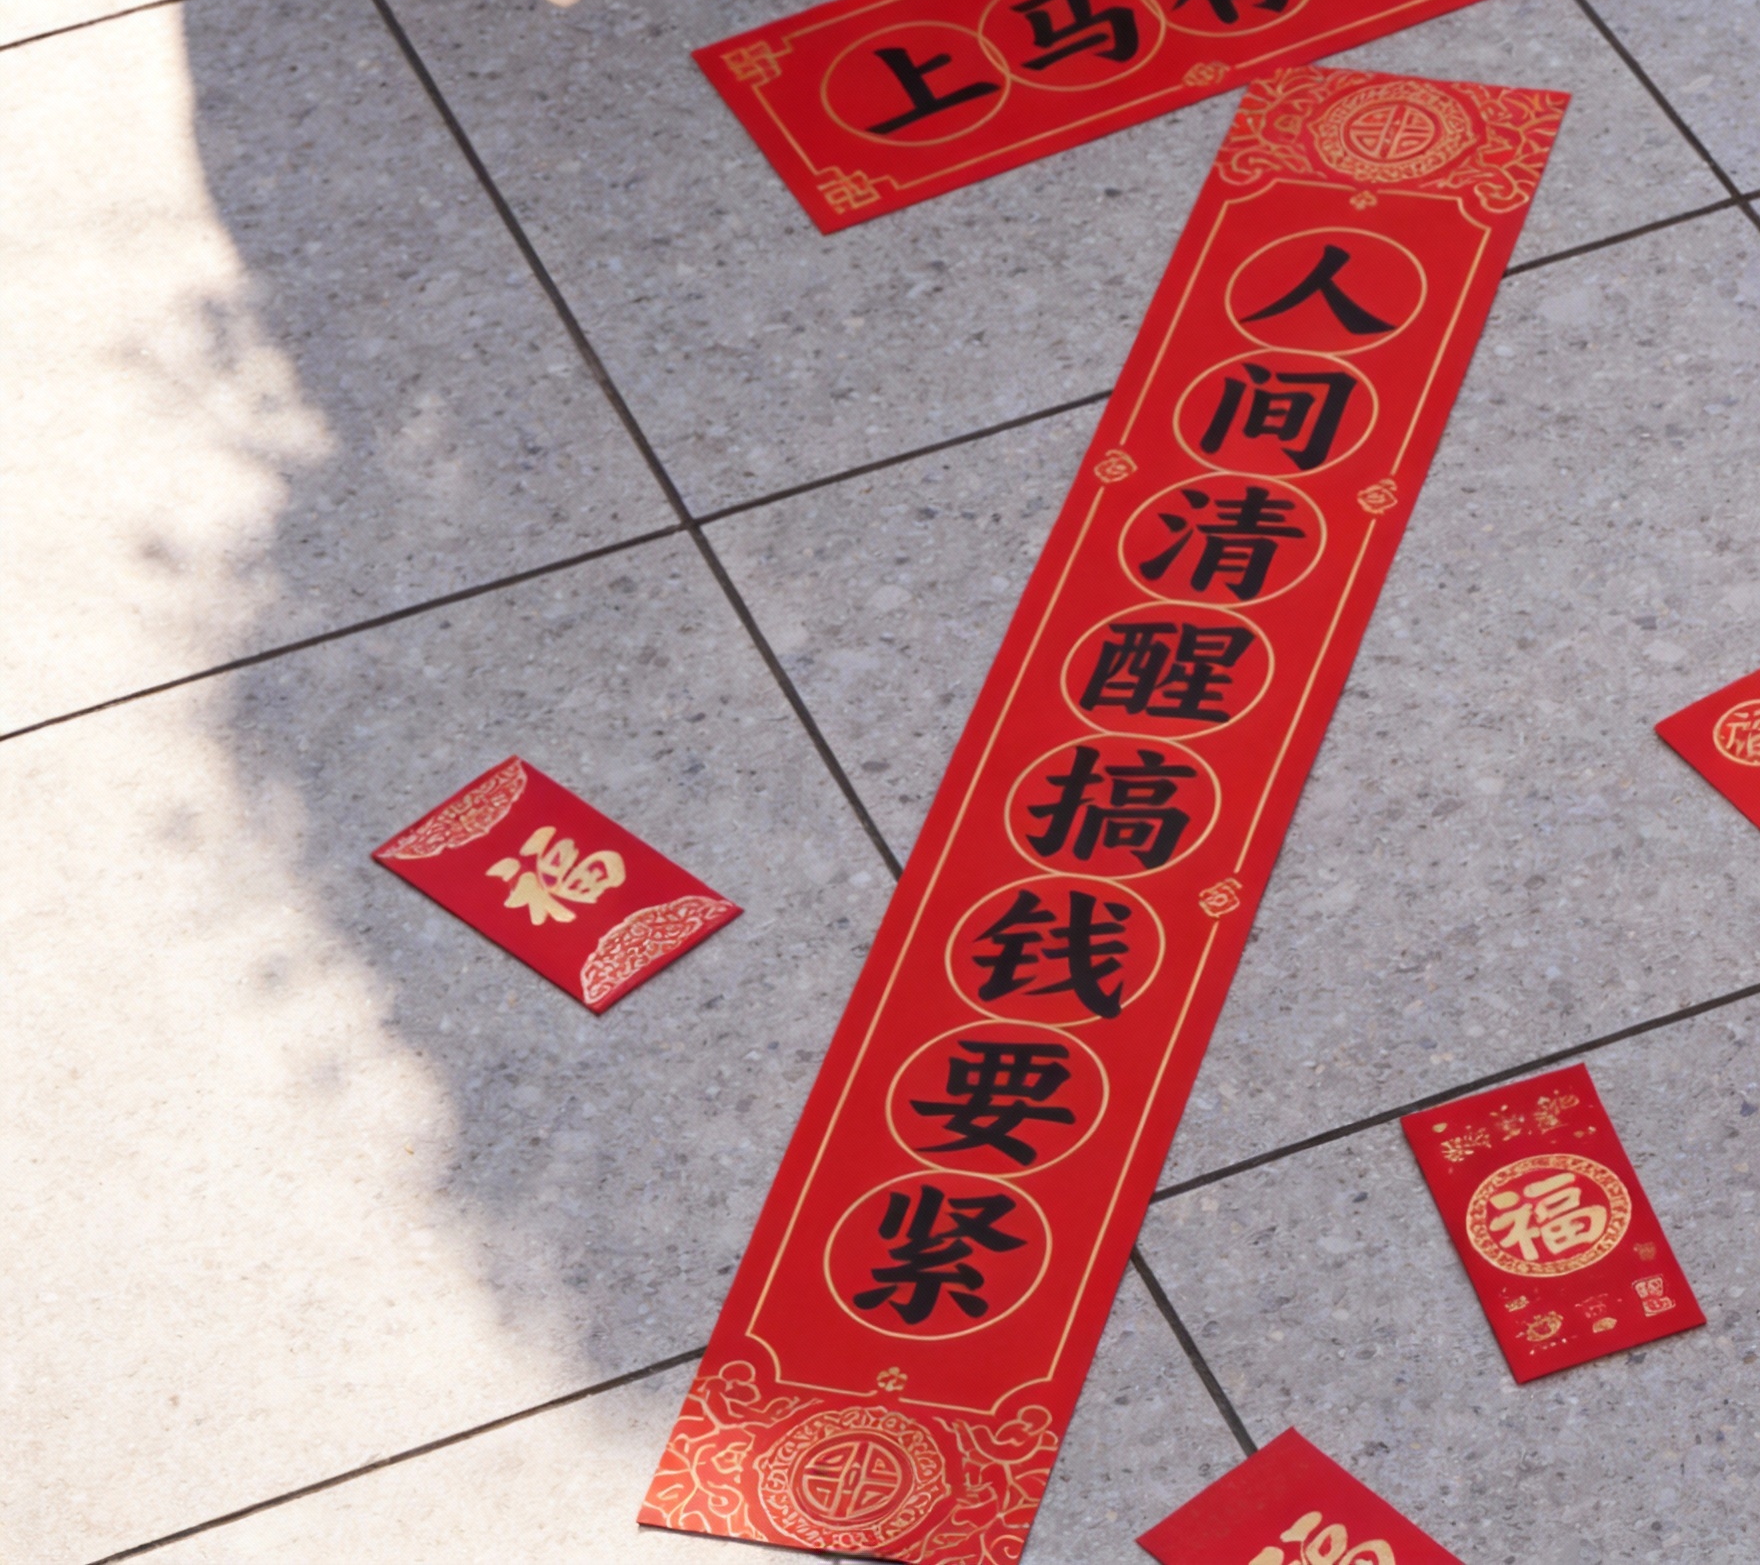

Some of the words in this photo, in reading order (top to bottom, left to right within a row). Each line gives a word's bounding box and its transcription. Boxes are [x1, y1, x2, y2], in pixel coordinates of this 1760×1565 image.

[852, 244, 1398, 1325] 人间清醒搞钱要紧
[484, 825, 627, 926] 福
[1488, 1172, 1608, 1262] 福
